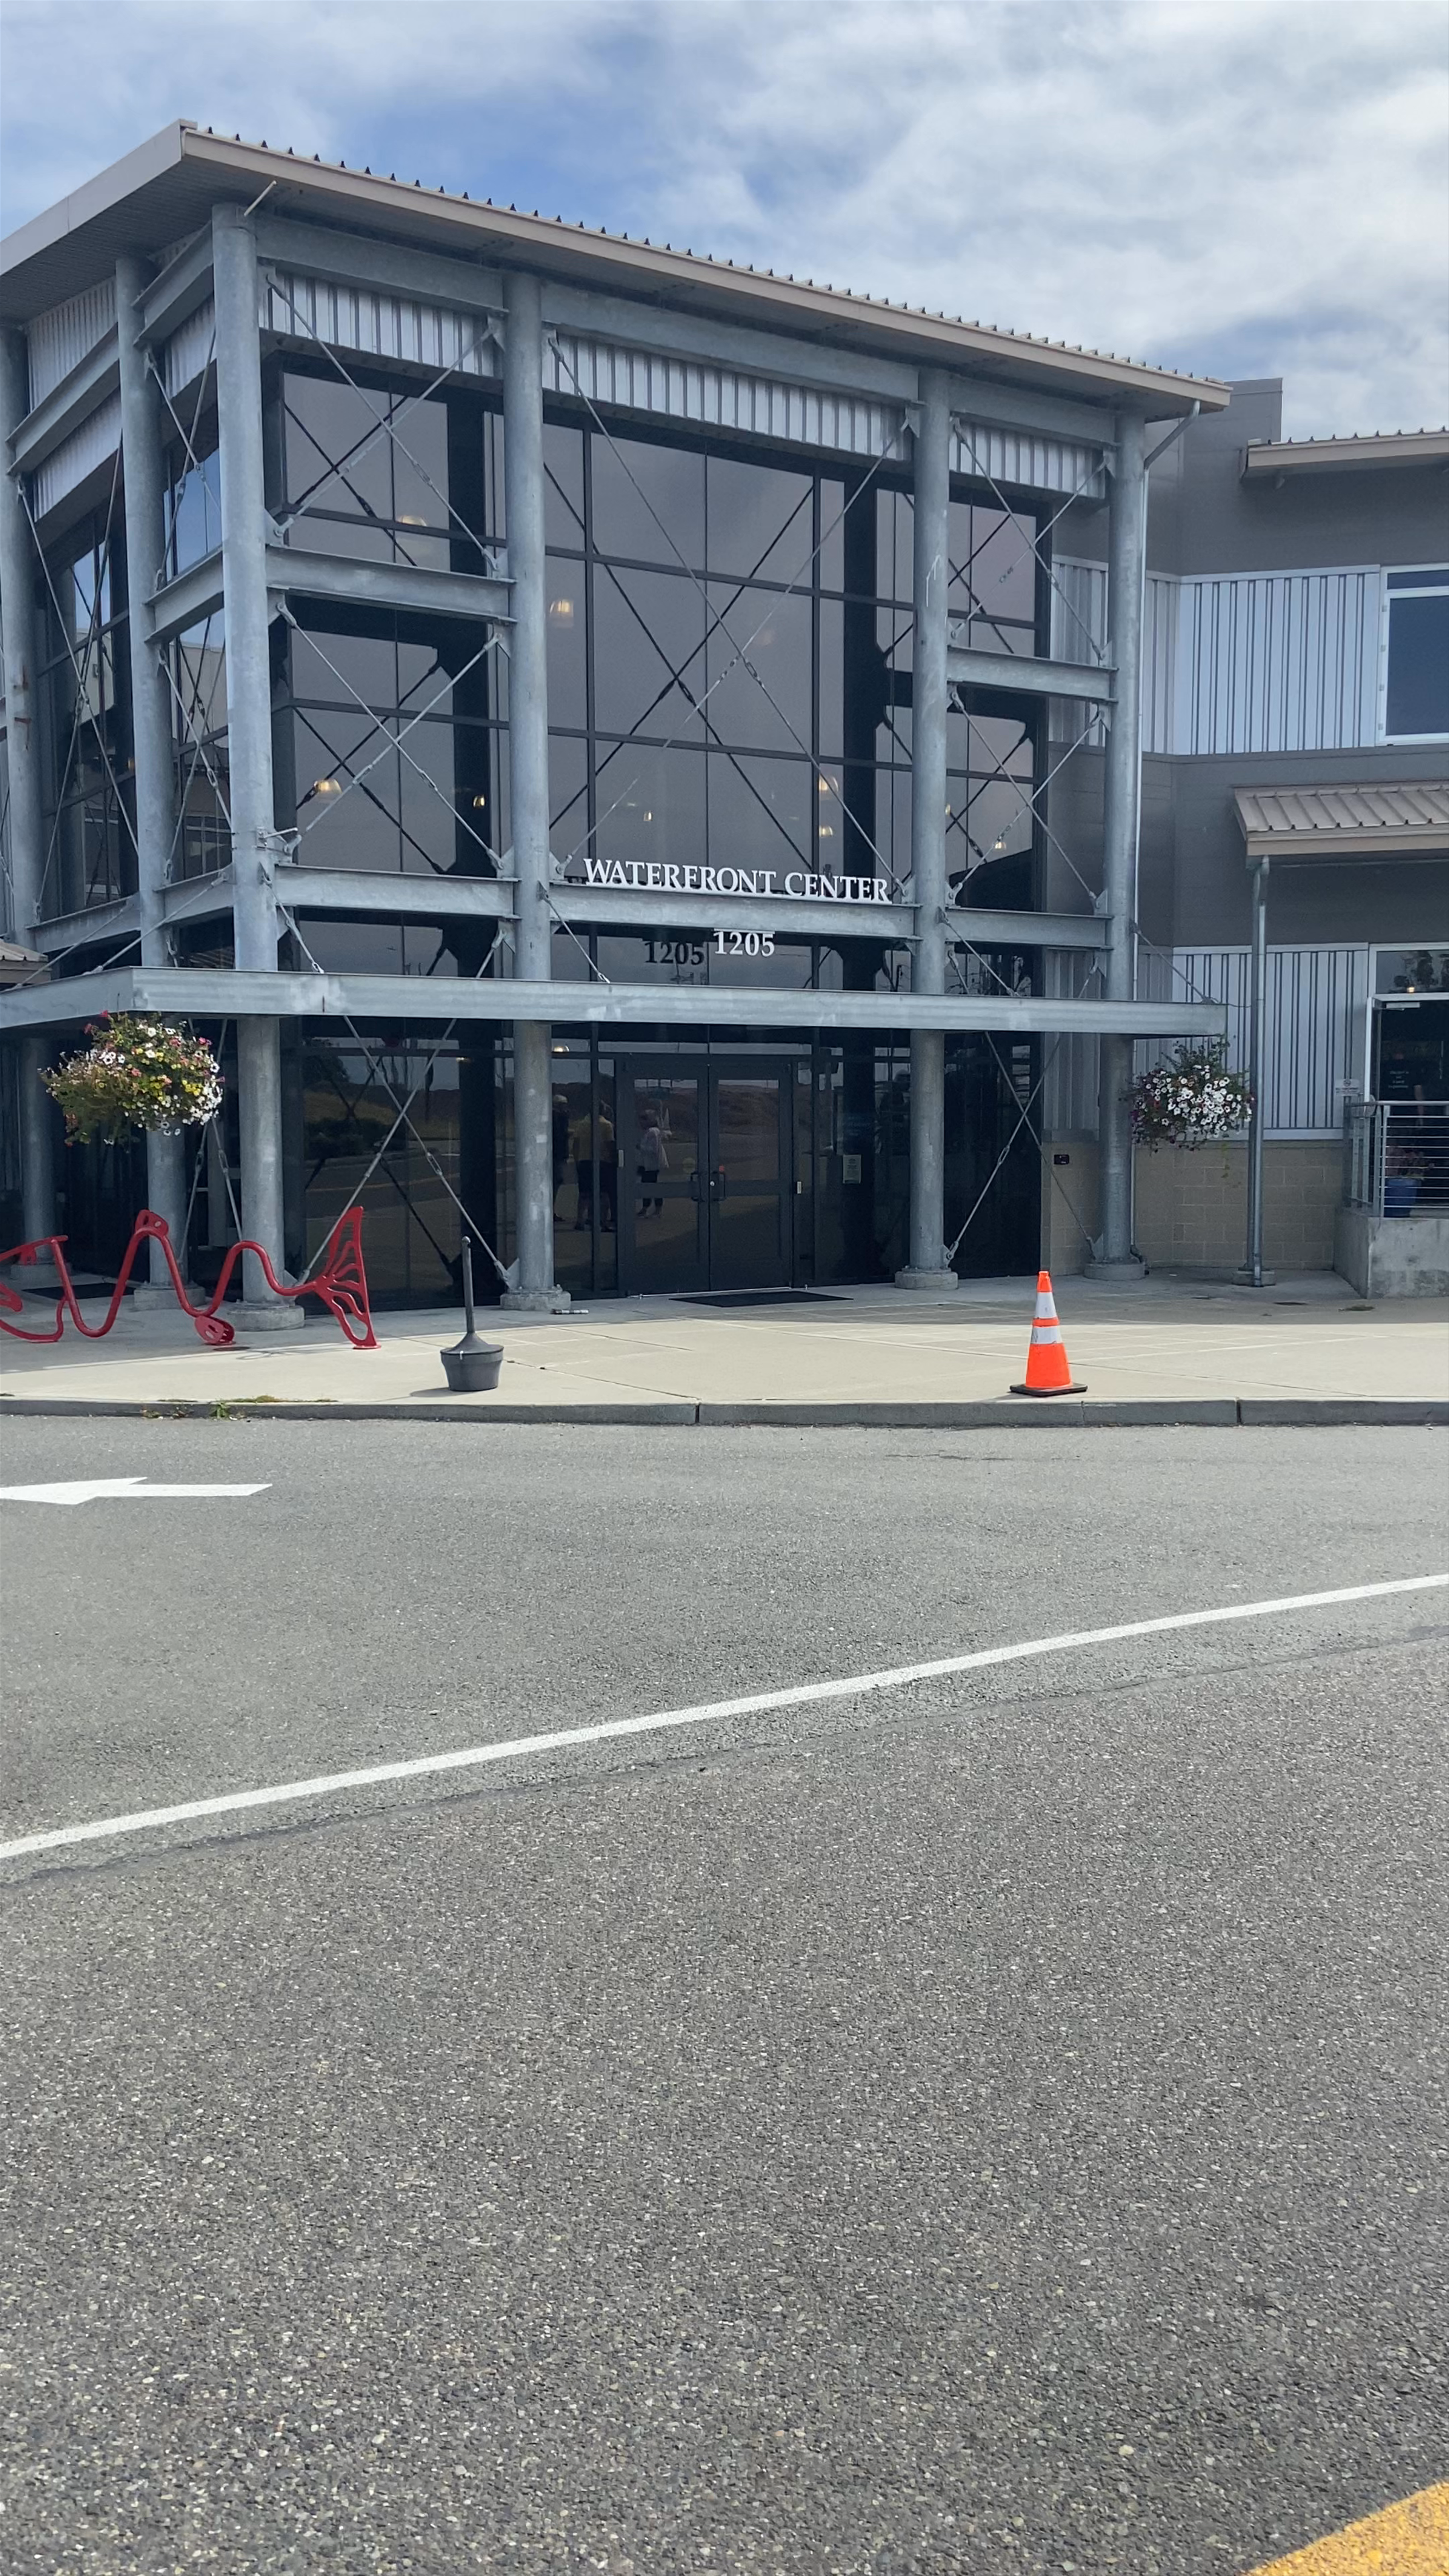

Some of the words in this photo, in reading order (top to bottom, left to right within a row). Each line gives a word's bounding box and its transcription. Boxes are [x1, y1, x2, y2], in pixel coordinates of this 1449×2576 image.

[583, 858, 776, 894] WATERFRONT
[784, 872, 892, 904] CENTER
[645, 941, 705, 965] 1205
[713, 931, 775, 957] 1205
